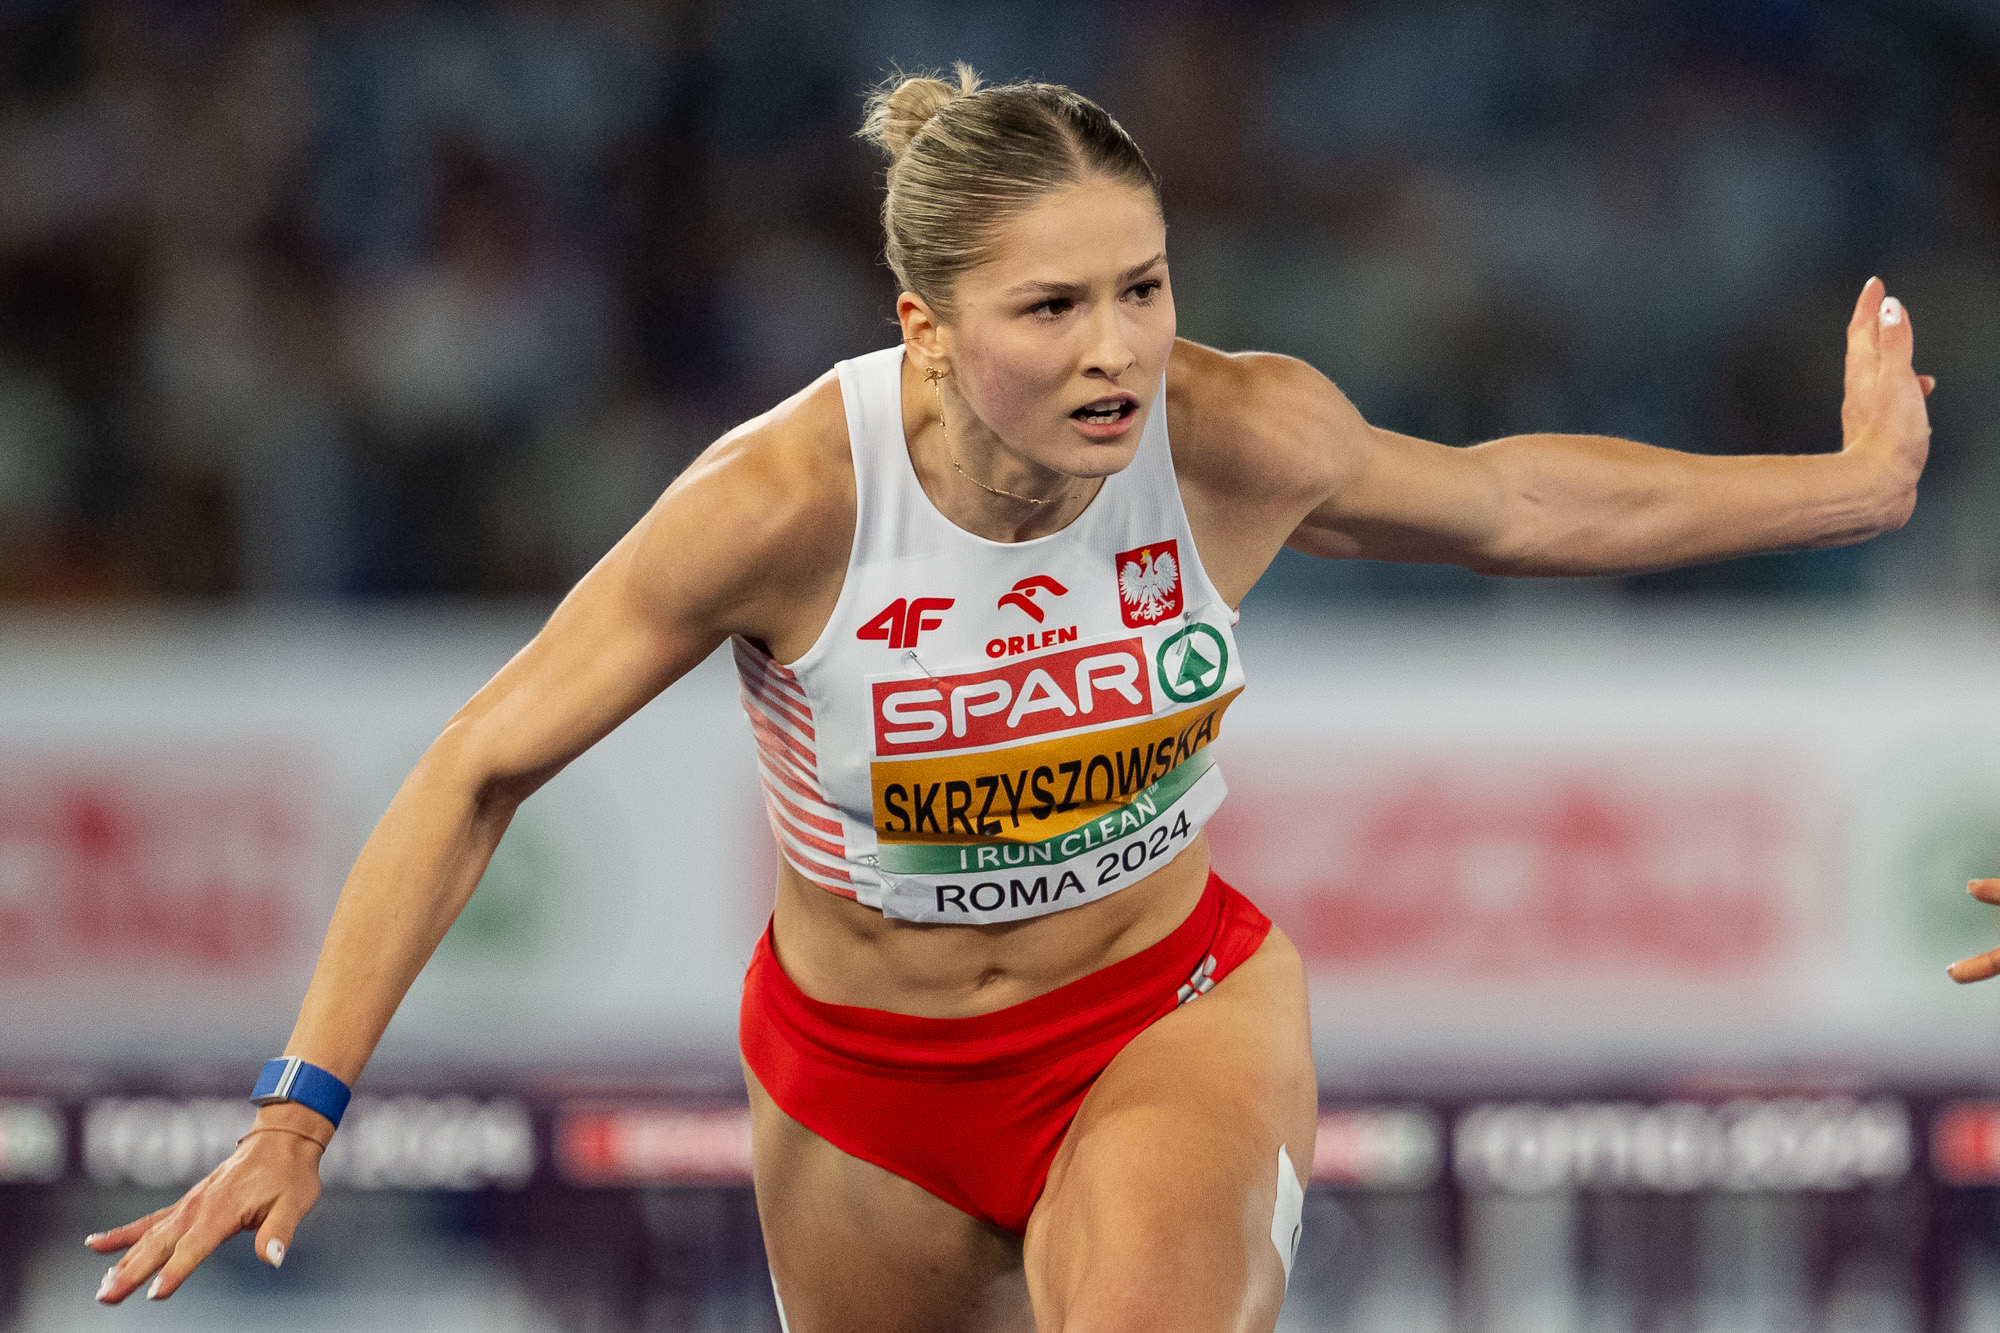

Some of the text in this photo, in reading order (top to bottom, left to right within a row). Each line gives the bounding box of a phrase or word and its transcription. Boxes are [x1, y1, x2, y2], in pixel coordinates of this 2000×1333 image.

[856, 597, 956, 649] 4F
[985, 625, 1078, 659] ORLEN
[881, 651, 1144, 745] SPAR
[884, 708, 1218, 836] SKRZYSZOWSKA
[936, 809, 1192, 913] ROMA 2024
[960, 849, 968, 870] I
[977, 842, 1052, 869] RUN
